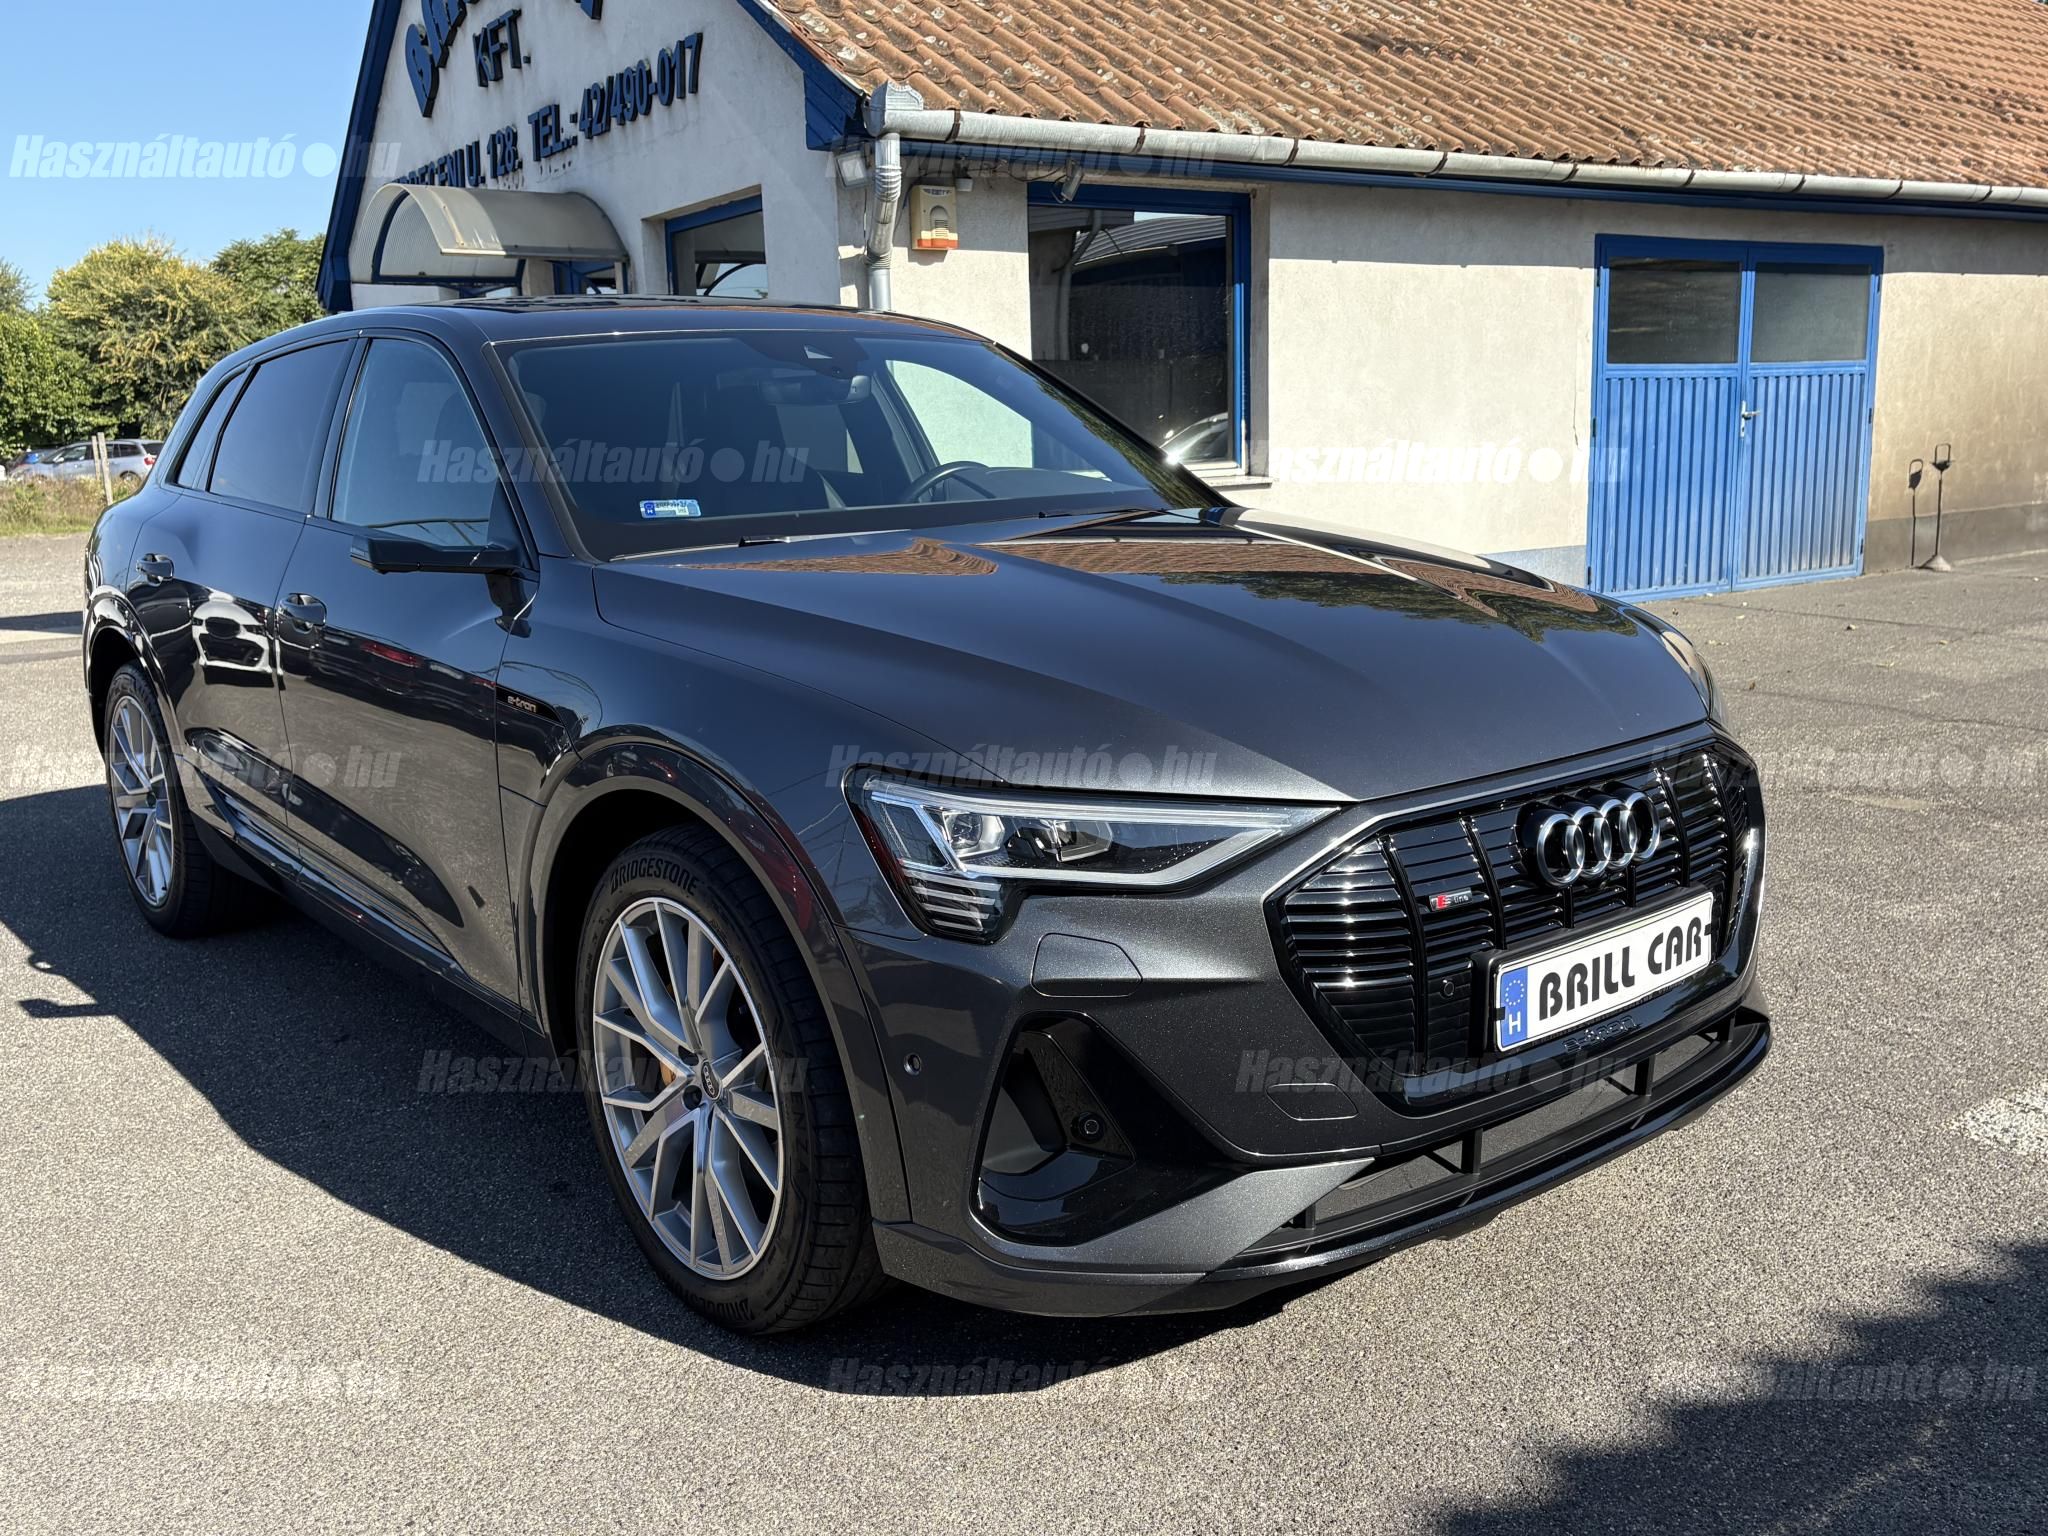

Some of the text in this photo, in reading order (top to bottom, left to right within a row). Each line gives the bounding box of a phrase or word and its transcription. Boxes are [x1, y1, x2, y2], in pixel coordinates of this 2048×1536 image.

[472, 9, 531, 87] KFT.
[466, 141, 486, 187] U.
[487, 124, 523, 179] 128.
[507, 695, 537, 713] e-tron
[610, 857, 700, 896] BRIDGESTONE
[1539, 946, 1635, 1021] BRILL
[1648, 917, 1702, 974] CAR
[1508, 1011, 1521, 1035] H
